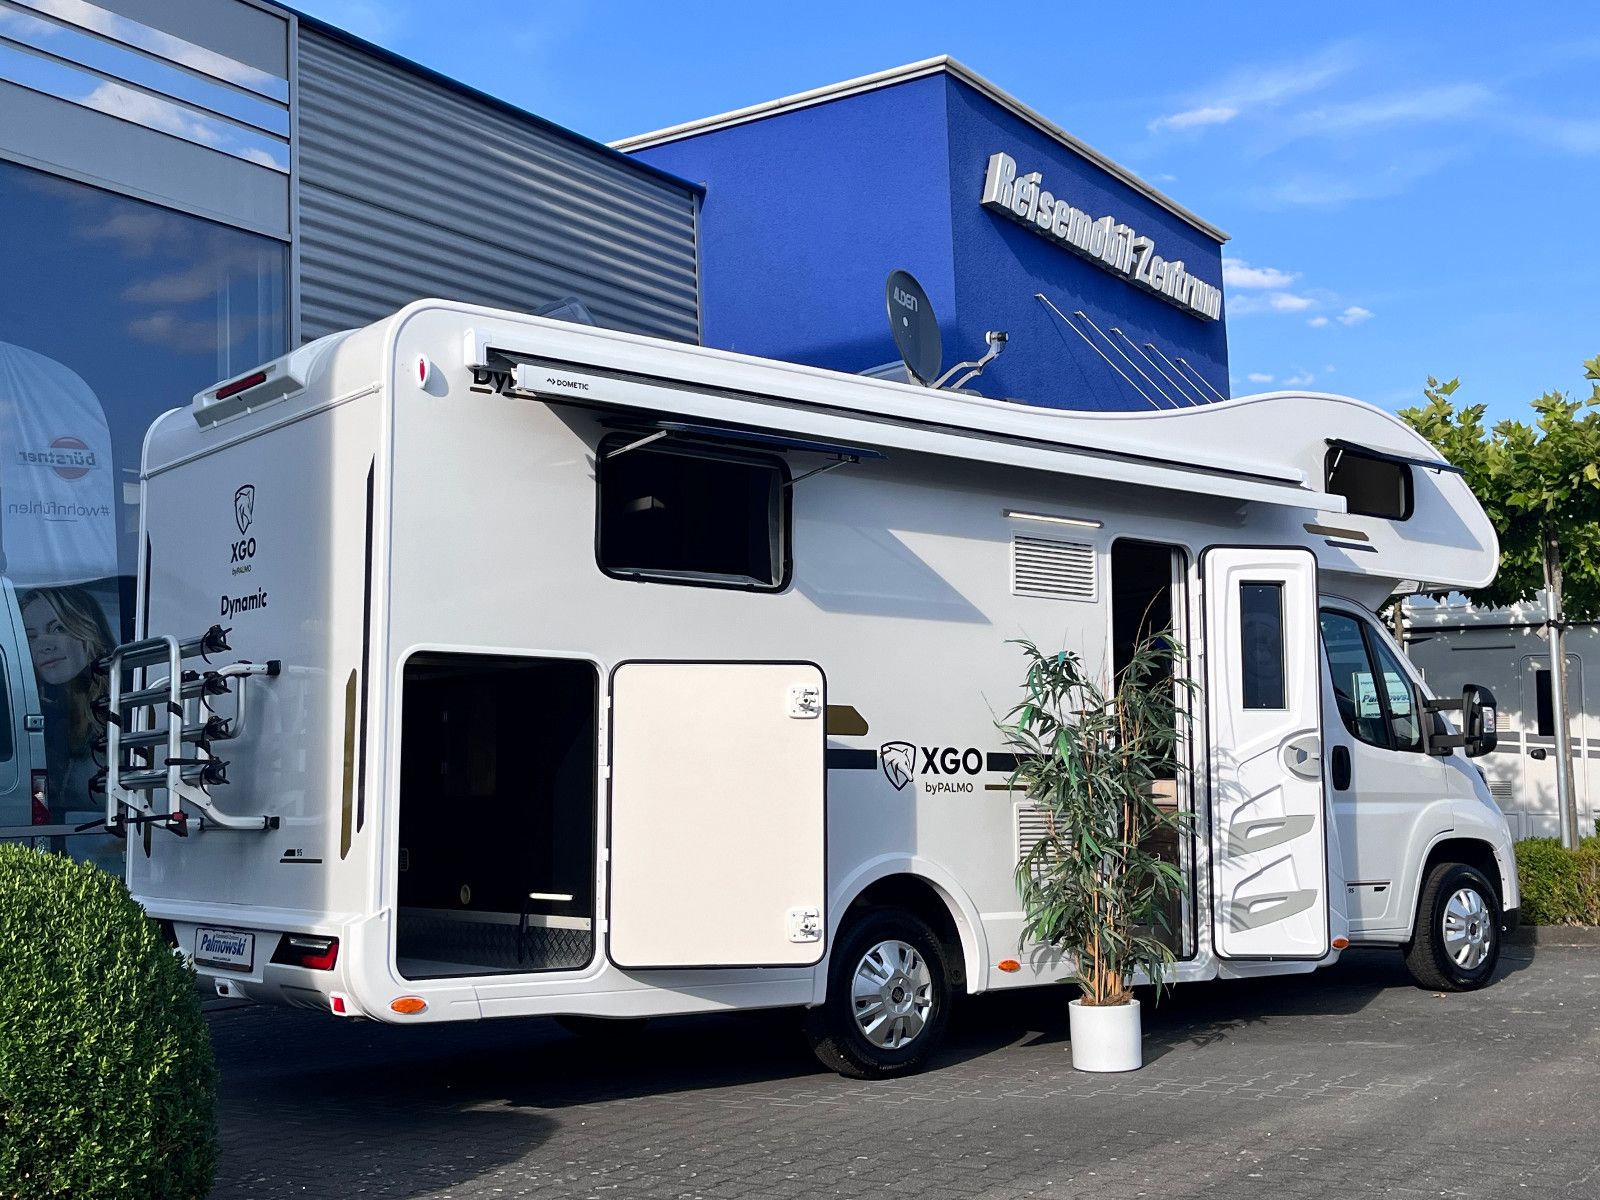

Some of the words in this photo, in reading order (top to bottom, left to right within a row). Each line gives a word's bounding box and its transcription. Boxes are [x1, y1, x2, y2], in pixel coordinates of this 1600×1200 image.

[981, 152, 1222, 321] Reisemobil-Zentrum
[556, 379, 590, 391] DOMETIC
[230, 537, 256, 564] XGO
[220, 586, 268, 620] Dynamic
[920, 746, 983, 775] XGO
[925, 781, 974, 796] byPALMO
[200, 933, 248, 957] Palmowski
